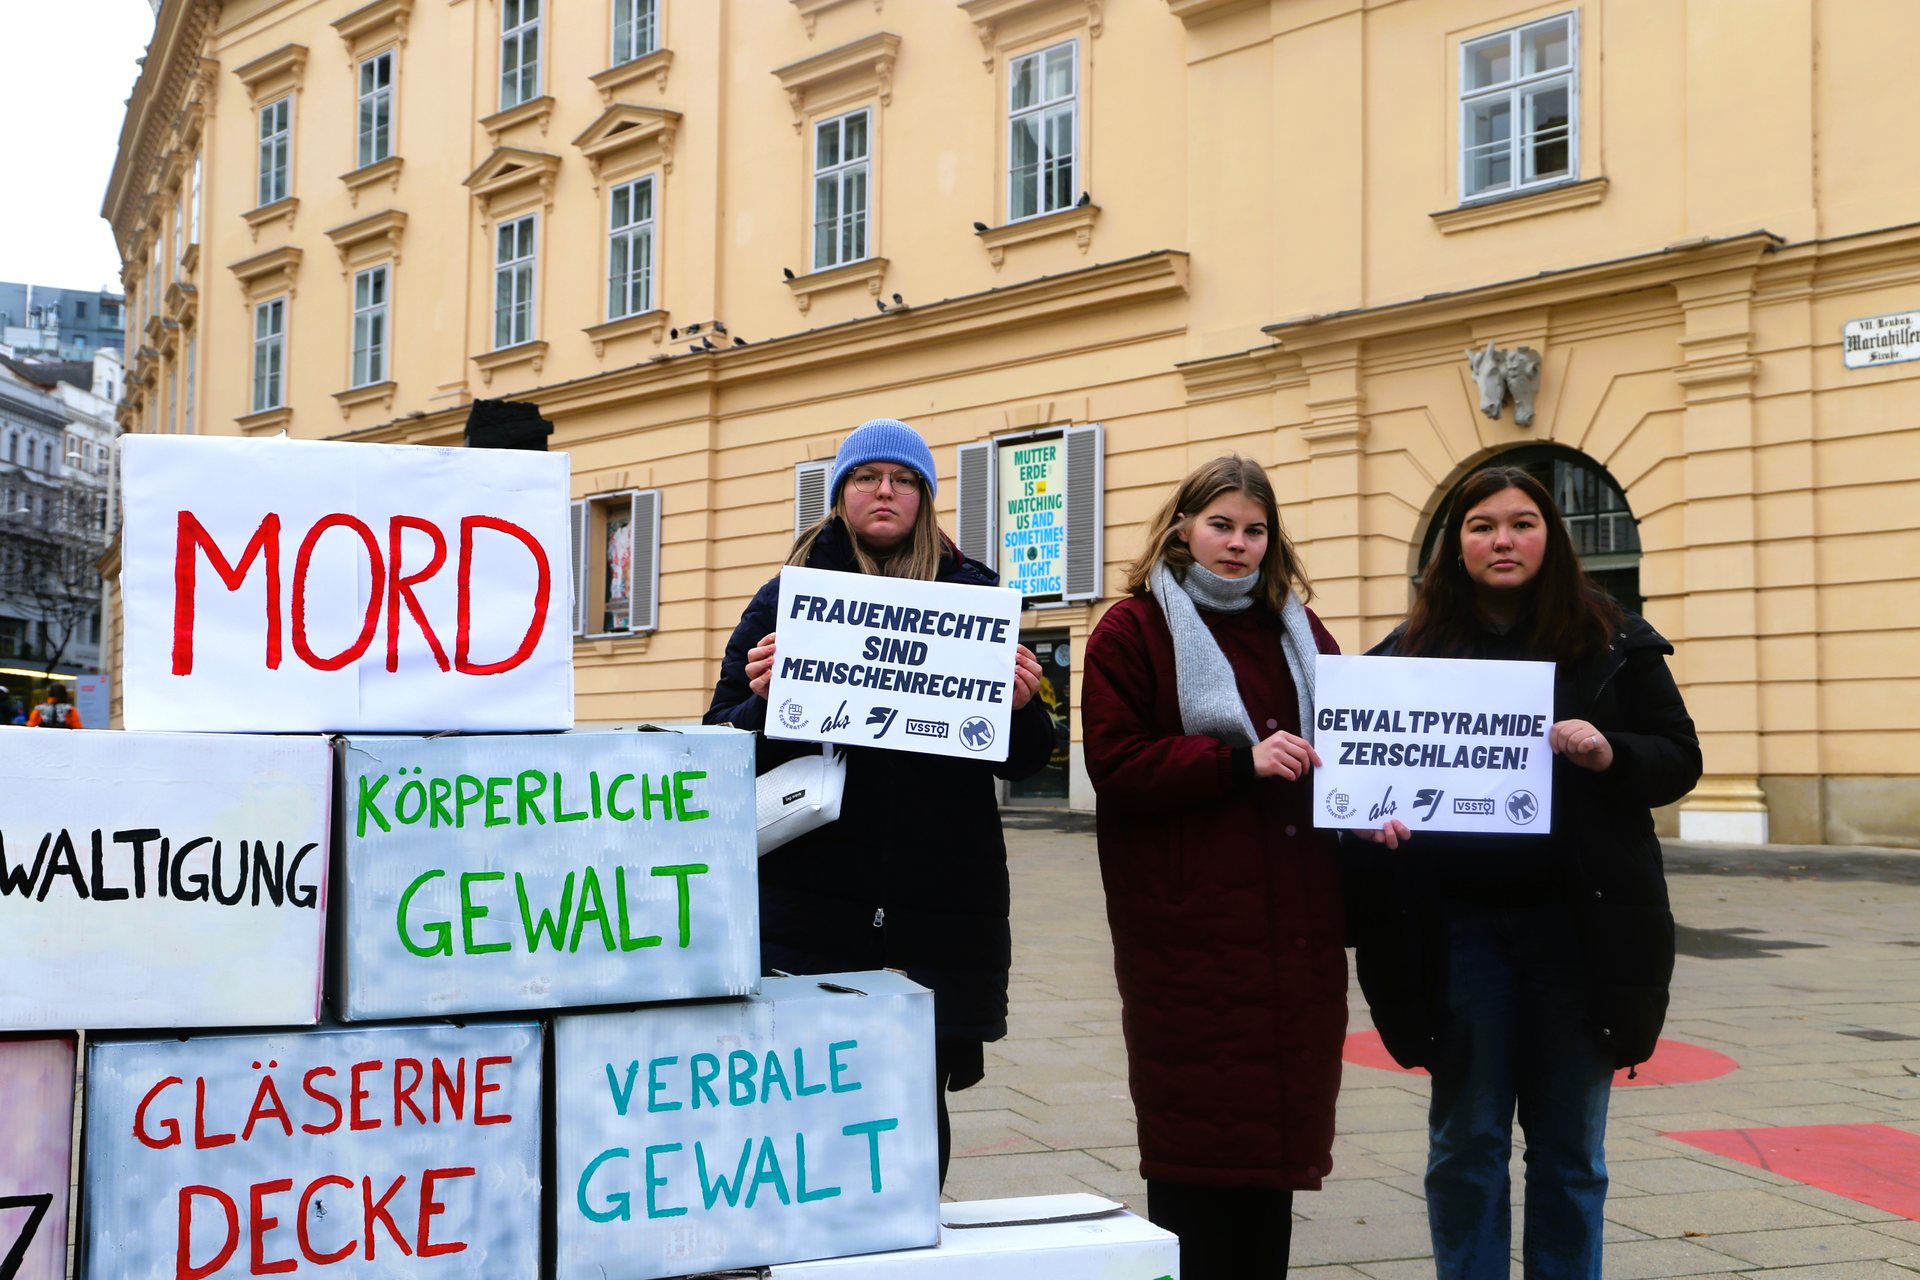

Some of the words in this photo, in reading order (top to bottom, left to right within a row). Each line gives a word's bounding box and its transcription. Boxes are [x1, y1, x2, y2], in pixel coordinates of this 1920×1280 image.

[1014, 446, 1056, 466] MUTTER
[1020, 463, 1047, 481] ERDE
[1024, 482, 1035, 496] IS
[1008, 494, 1063, 515] WATCHING
[1017, 515, 1030, 529] US
[1032, 511, 1054, 528] AND
[1013, 547, 1024, 562] IN
[1040, 544, 1060, 559] THE
[1019, 561, 1051, 577] NIGHT
[173, 512, 550, 676] MORD
[1030, 576, 1061, 593] SINGS
[790, 595, 1010, 643] FRAUENRECHTE
[863, 636, 928, 666] SIND
[781, 657, 1006, 703] MENSCHENRECHTE
[1317, 708, 1546, 737] GEWALTPYRAMIDE
[1338, 742, 1529, 770] ZERSCHLAGEN!
[357, 767, 709, 837] KÖRPERLICHE
[0, 829, 318, 908] WALTIGUNG
[398, 864, 708, 957] GEWALT
[606, 1040, 861, 1115] VERBALE
[134, 1057, 512, 1149] GLÄSERNE
[577, 1118, 898, 1222] GEWALT
[176, 1168, 475, 1280] DECKE
